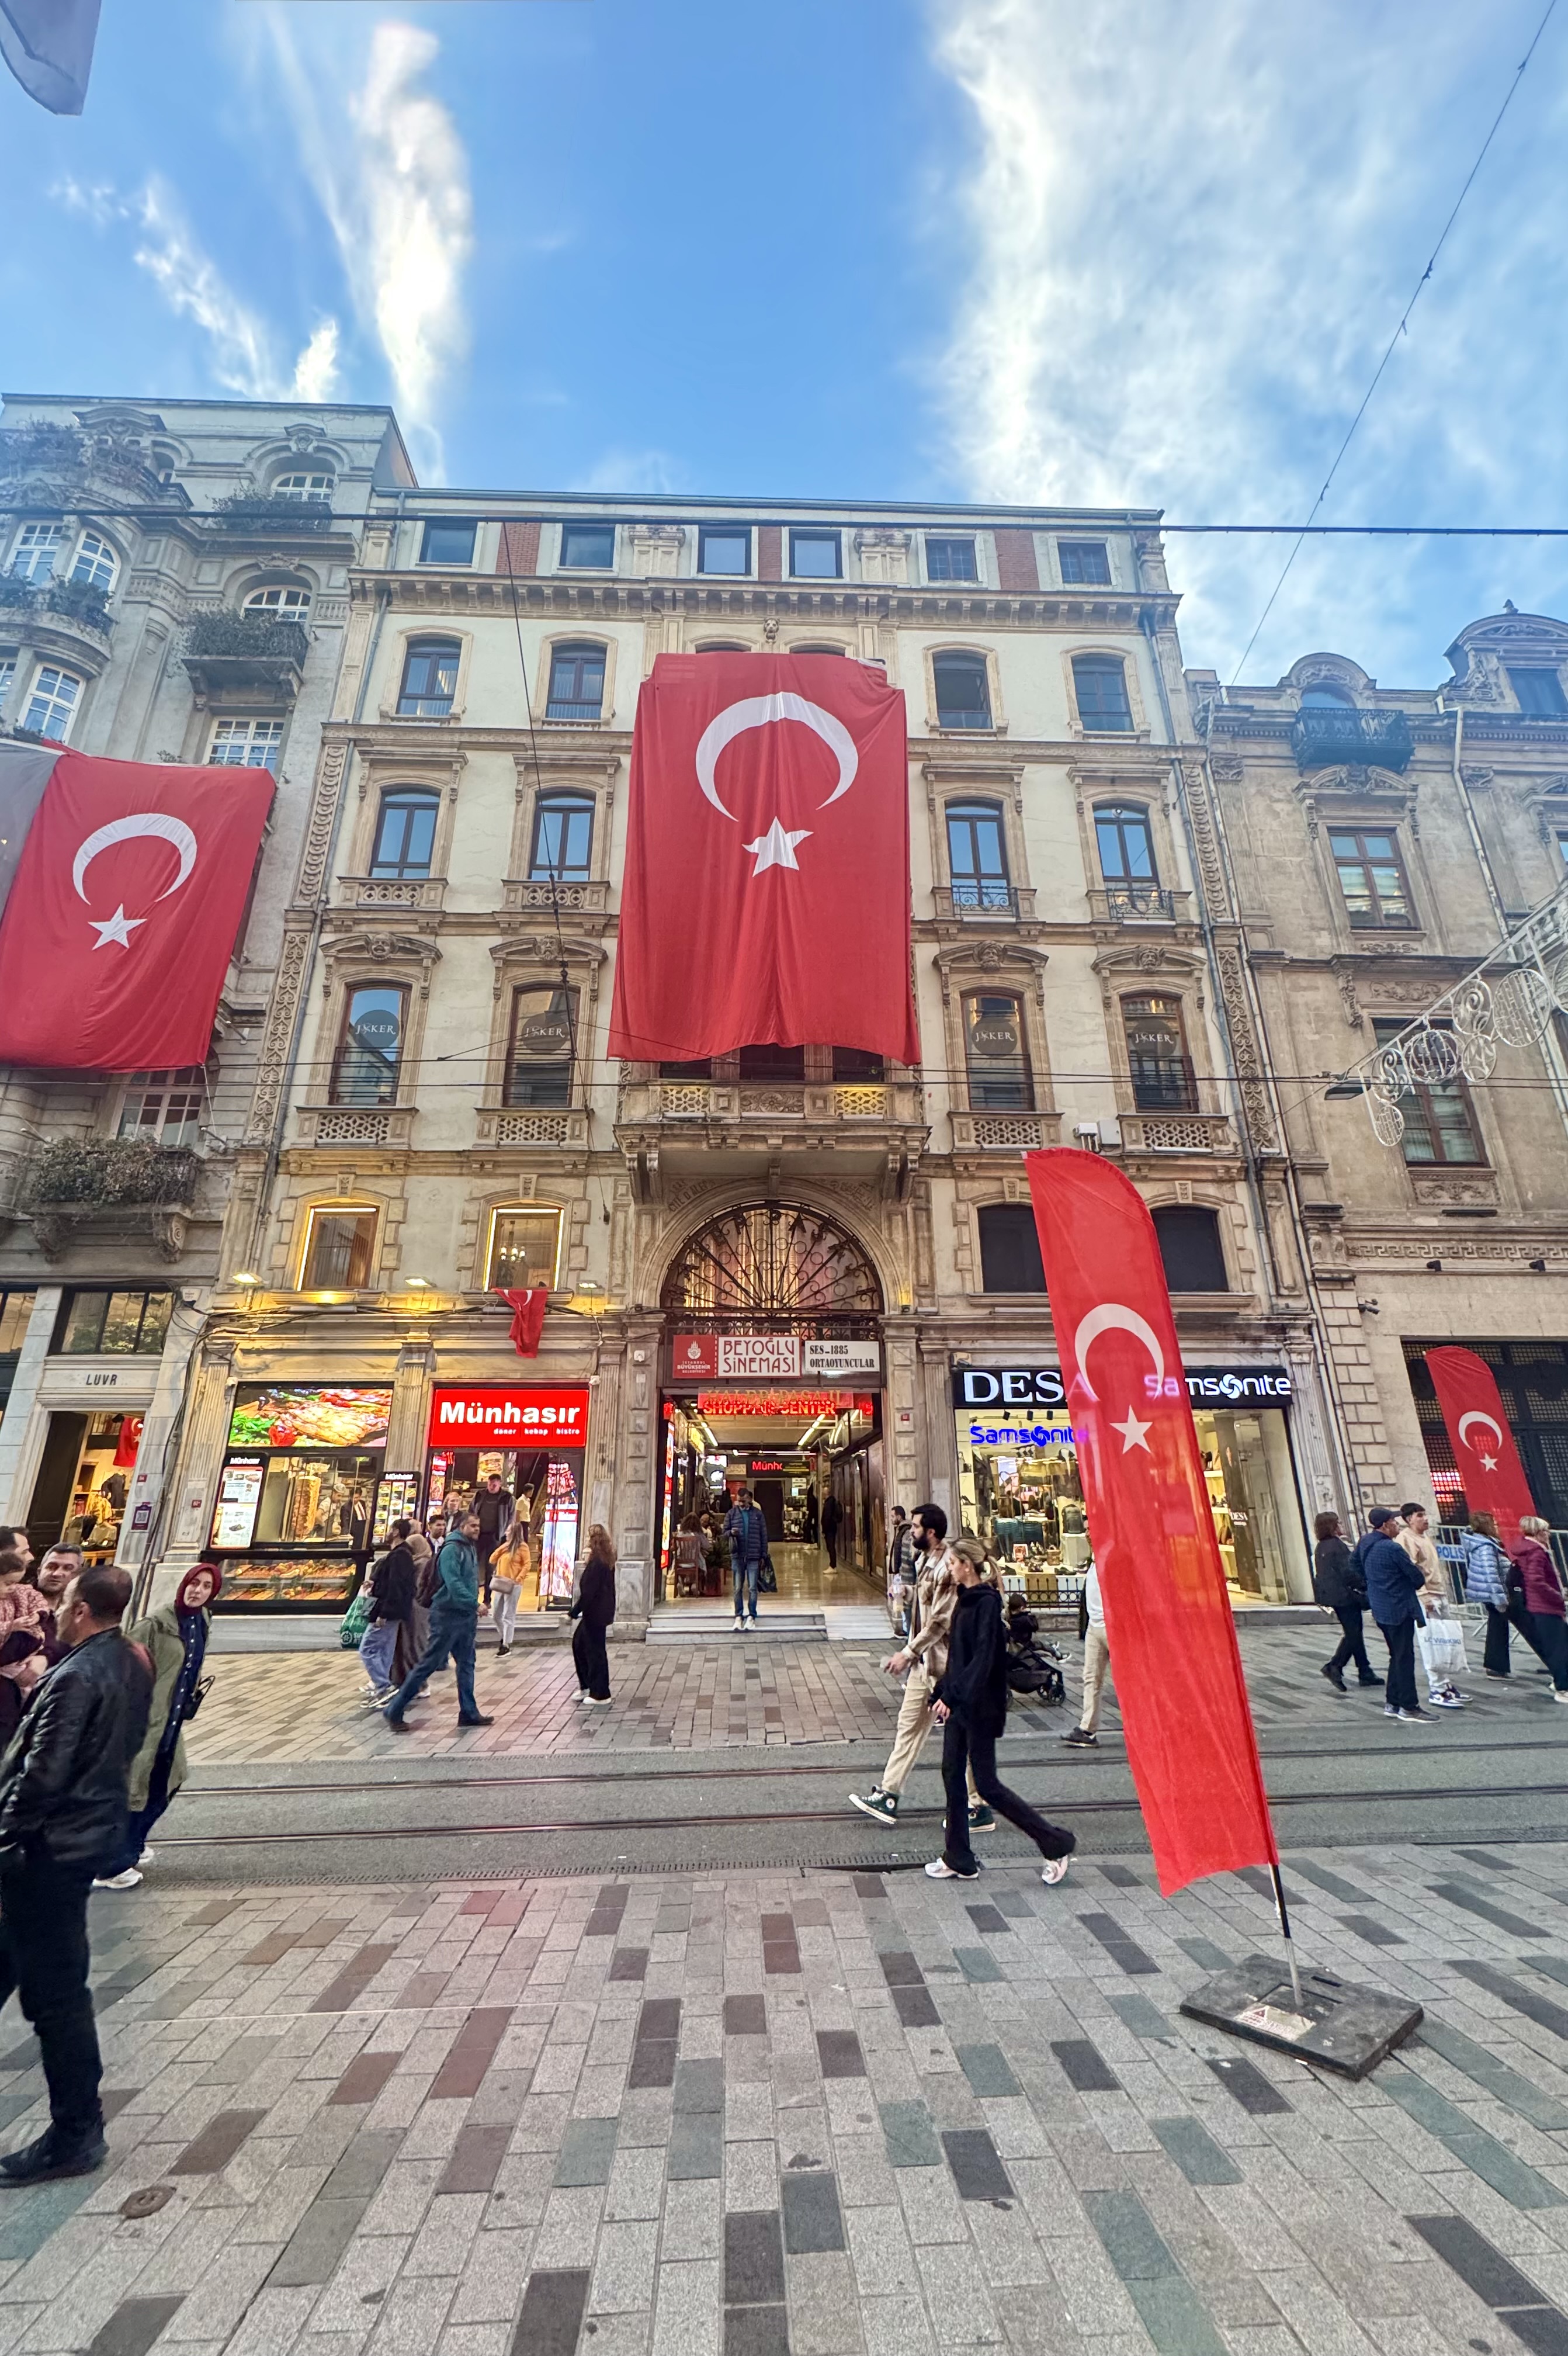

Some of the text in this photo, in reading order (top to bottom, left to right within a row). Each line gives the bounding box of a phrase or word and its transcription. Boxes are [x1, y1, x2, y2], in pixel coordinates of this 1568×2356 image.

[723, 1338, 795, 1356] BEYOĞLU
[810, 1359, 875, 1368] ORTAOYUNCULAR
[86, 1374, 117, 1385] LUVR
[963, 1371, 1101, 1402] DESA
[440, 1402, 580, 1424] Münhasır
[524, 1428, 548, 1436] kebap
